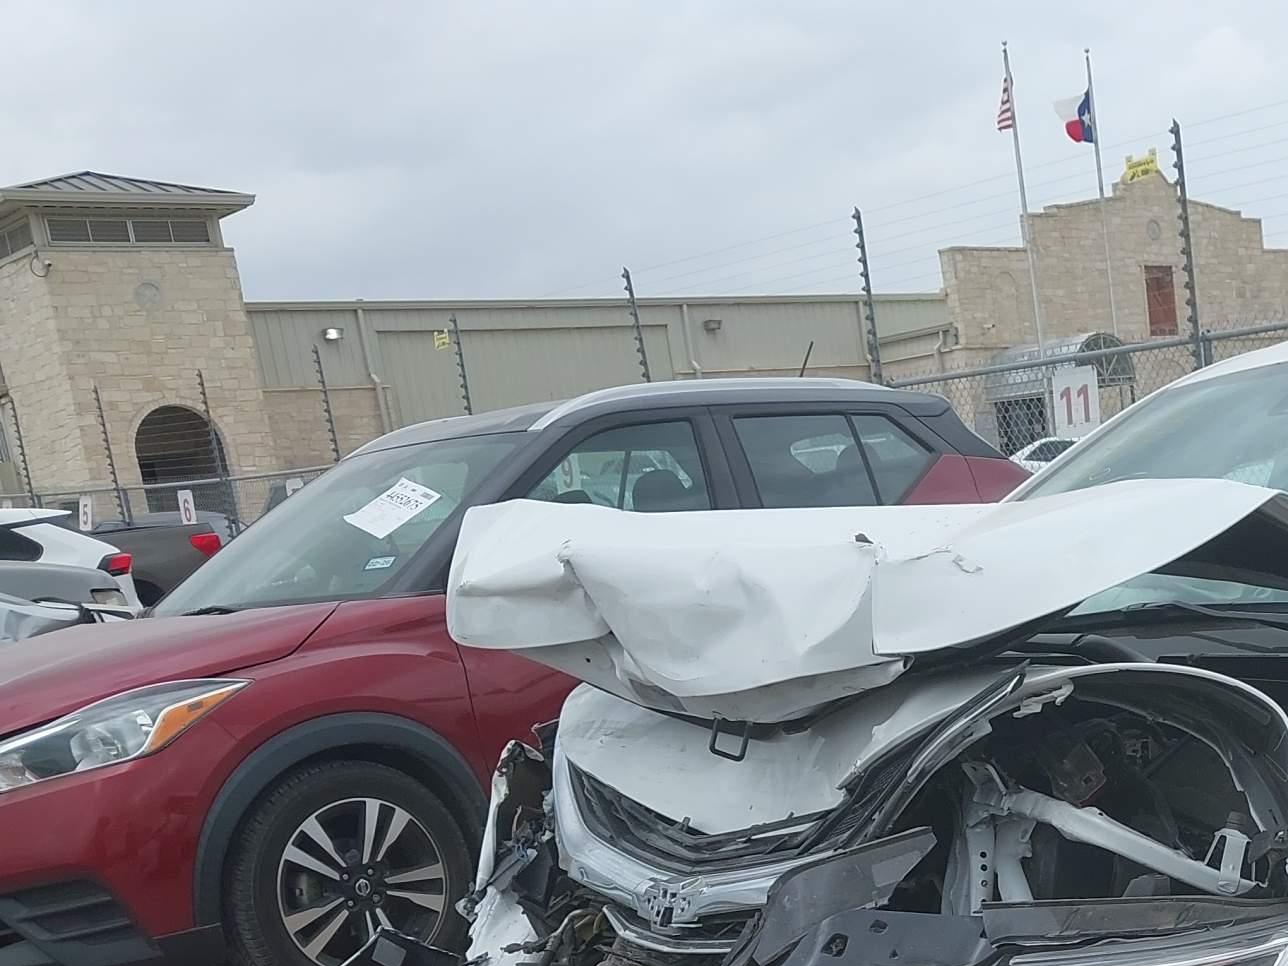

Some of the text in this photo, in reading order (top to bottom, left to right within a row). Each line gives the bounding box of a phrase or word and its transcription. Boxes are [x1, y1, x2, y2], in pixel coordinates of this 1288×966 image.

[1060, 384, 1090, 425] 11
[82, 503, 89, 525] 5
[183, 498, 192, 522] 6
